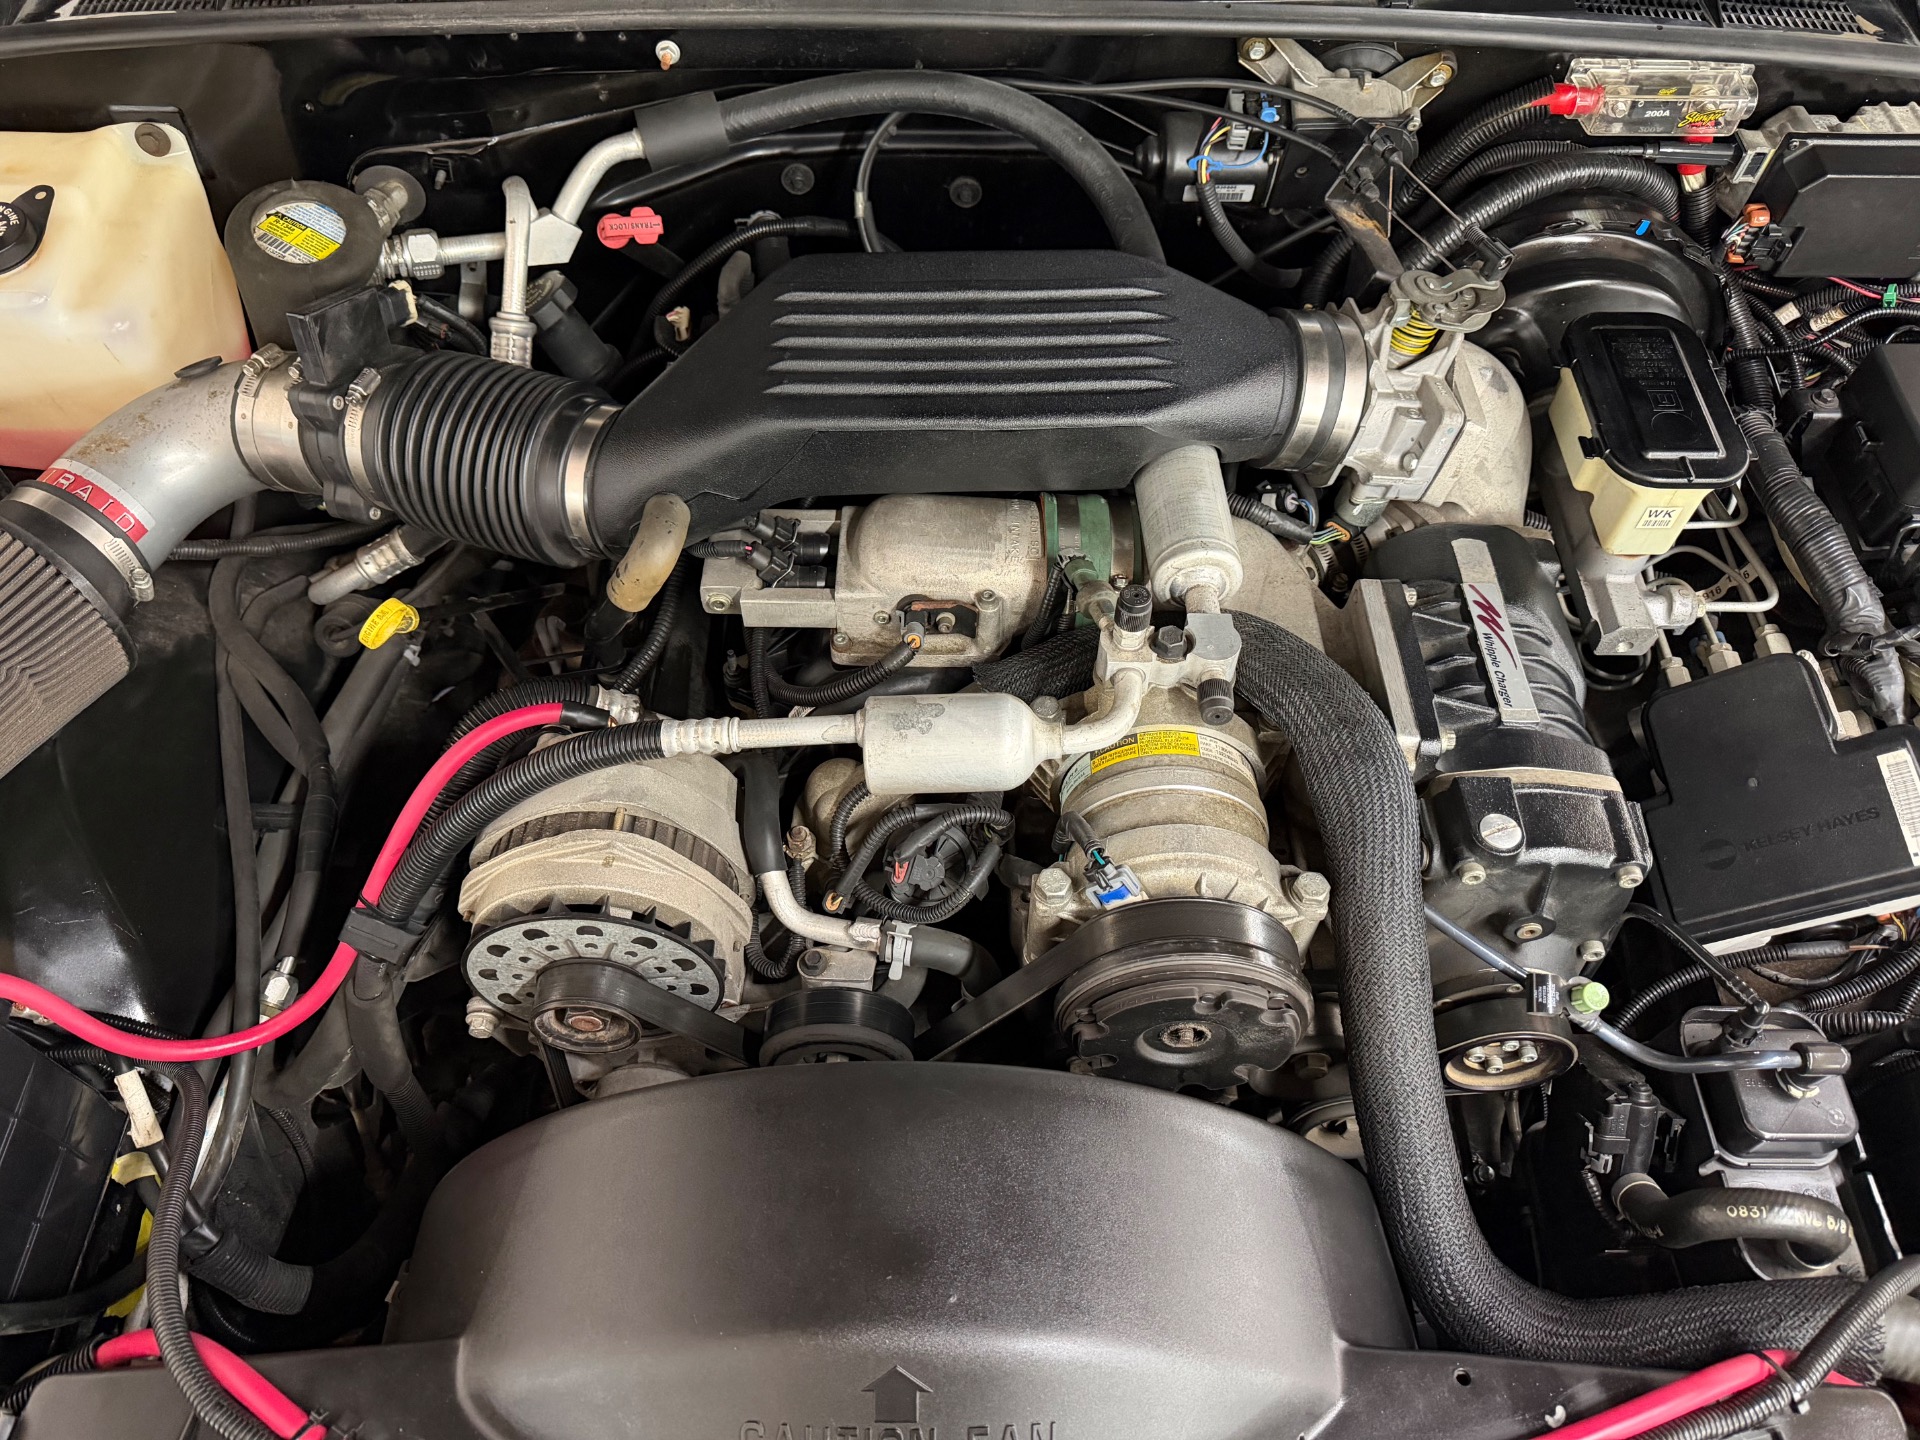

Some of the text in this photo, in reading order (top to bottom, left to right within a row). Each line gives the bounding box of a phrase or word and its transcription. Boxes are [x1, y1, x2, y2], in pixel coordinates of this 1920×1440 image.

[1643, 109, 1670, 118] 200A
[1677, 109, 1728, 128] Stinger
[283, 216, 307, 230] CAUTION
[1647, 509, 1676, 519] WK
[1702, 585, 1722, 601] 916
[1482, 632, 1513, 708] Whipple Charger
[1743, 805, 1880, 851] KELSEY HAYES
[1726, 1205, 1767, 1219] 0831
